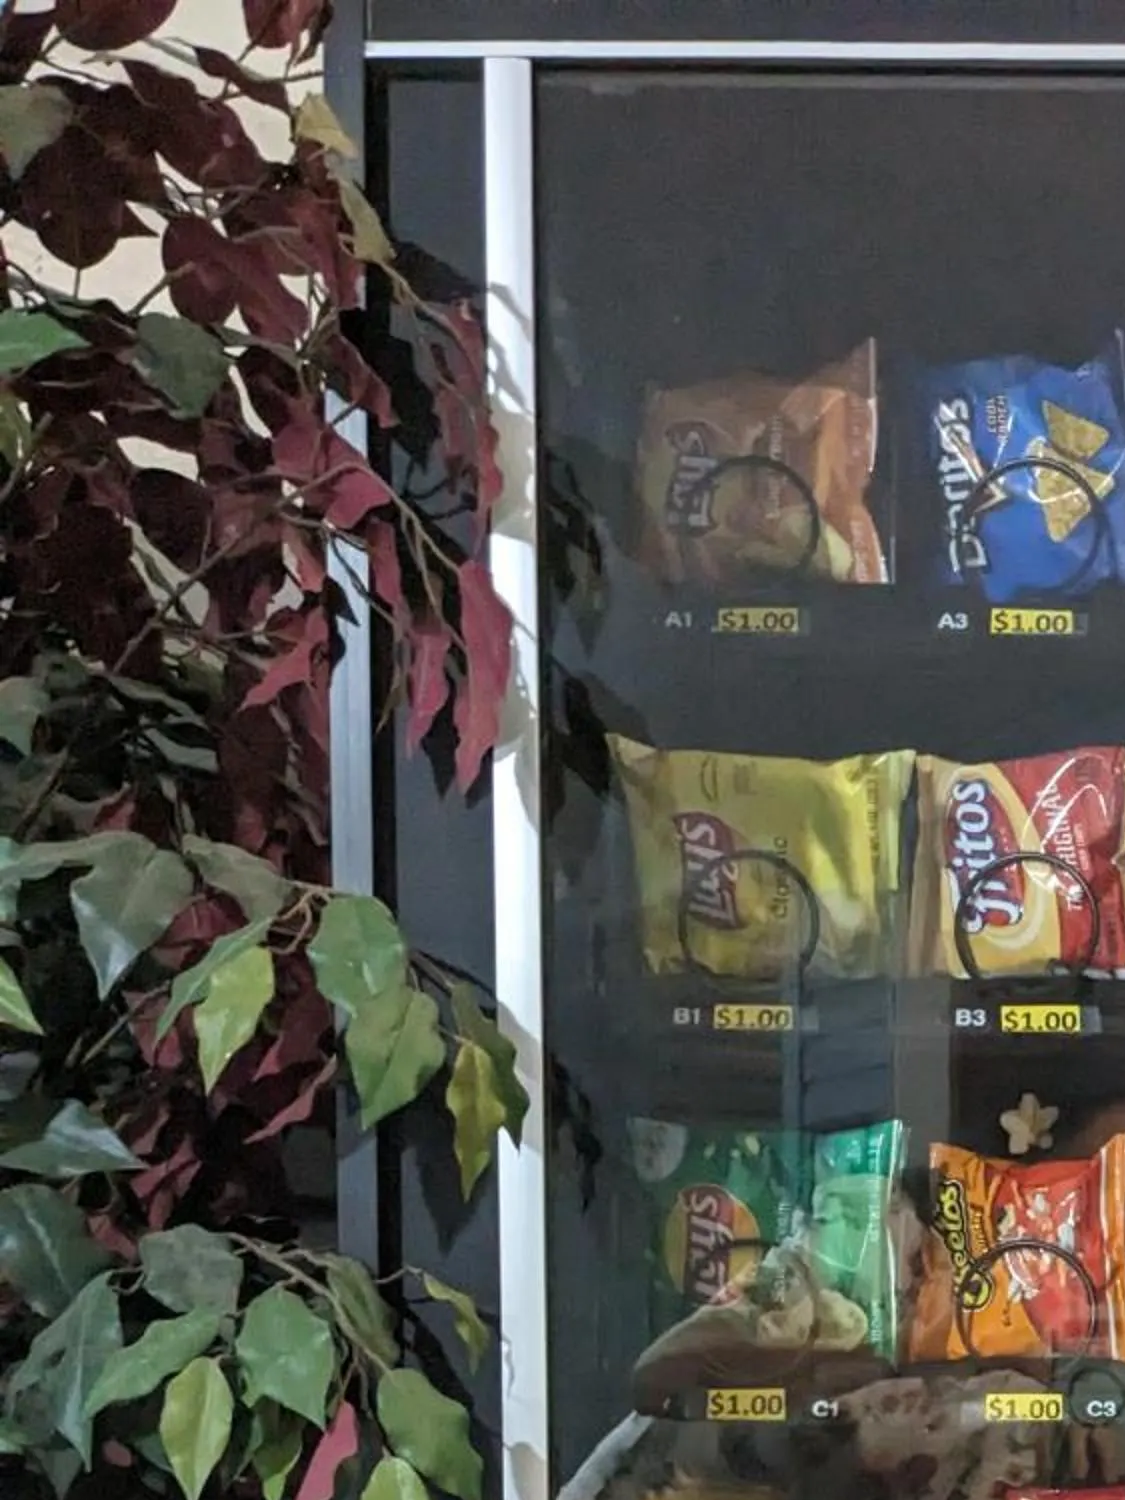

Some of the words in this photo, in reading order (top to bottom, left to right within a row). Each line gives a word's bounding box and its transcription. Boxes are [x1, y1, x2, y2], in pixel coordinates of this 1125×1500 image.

[664, 612, 693, 627] A1
[719, 610, 795, 632] $1.00
[937, 612, 969, 630] A3
[993, 610, 1068, 632] $1.00
[672, 1007, 701, 1025] B1
[716, 1007, 790, 1029] $1.00
[955, 1009, 987, 1027] B3
[1003, 1010, 1077, 1032] $1.00
[710, 1394, 783, 1417] $1.00
[811, 1400, 840, 1418] C1
[988, 1399, 1061, 1421] $1.00
[1086, 1400, 1117, 1418] C3
